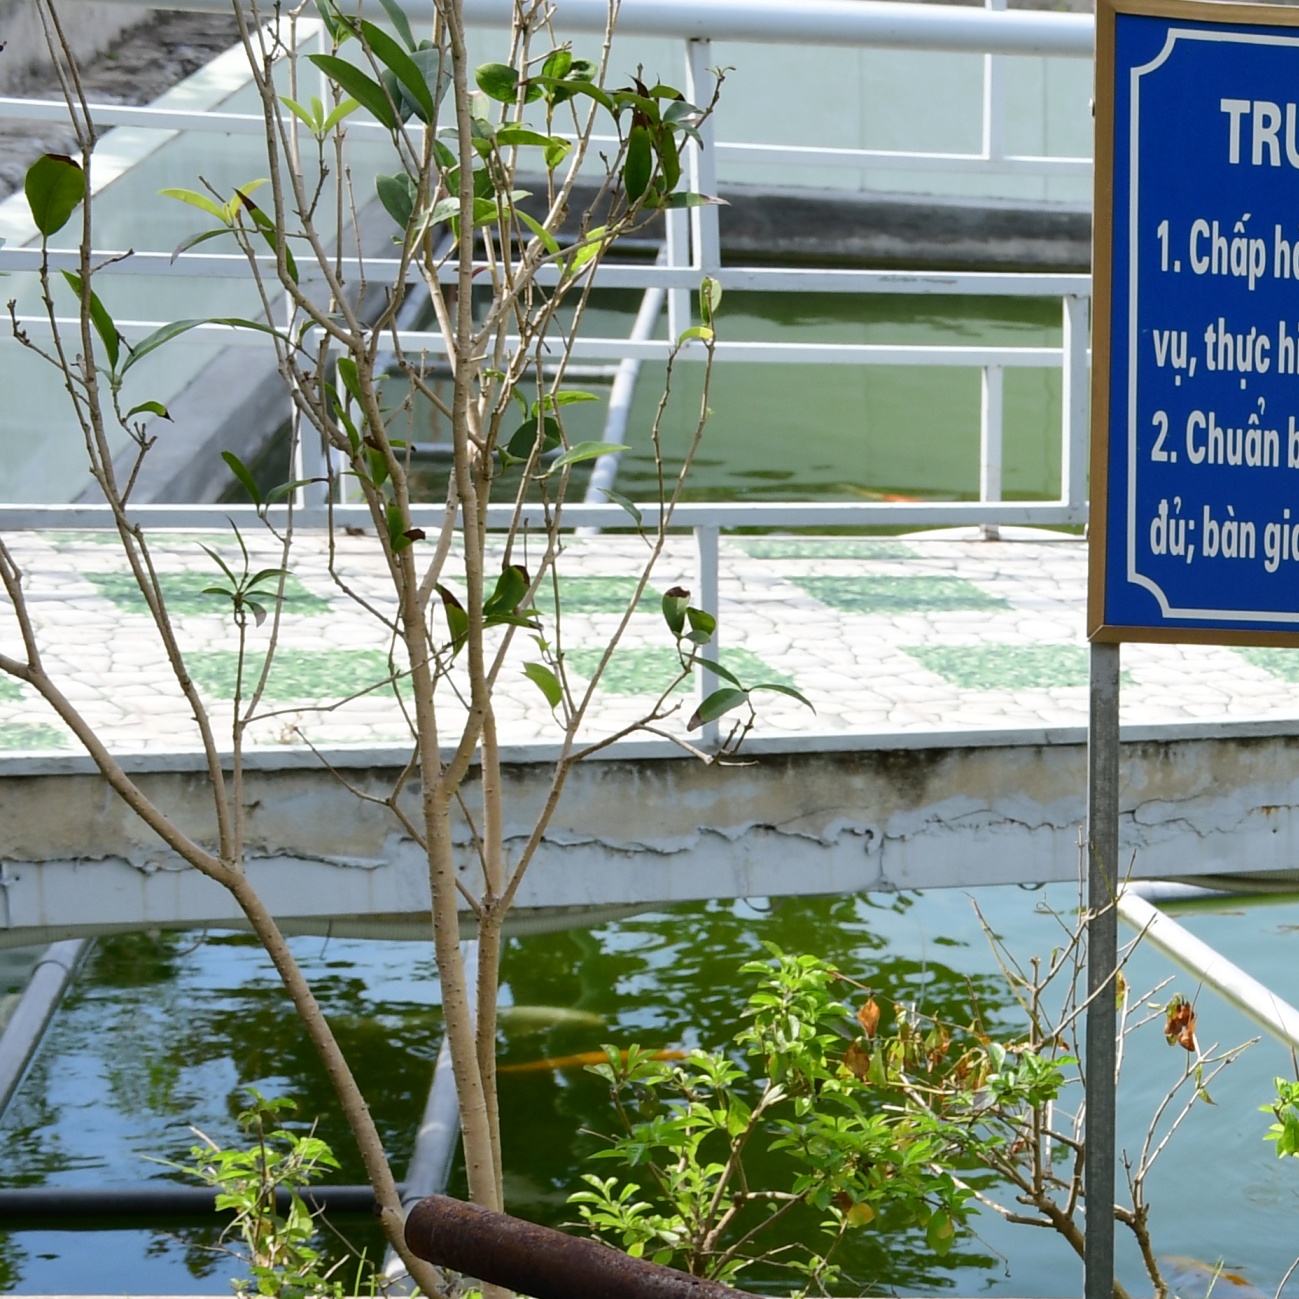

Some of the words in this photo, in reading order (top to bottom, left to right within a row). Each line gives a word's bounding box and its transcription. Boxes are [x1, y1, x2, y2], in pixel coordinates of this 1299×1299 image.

[1158, 219, 1180, 272] 1.
[1190, 214, 1265, 290] Chấp
[1153, 330, 1196, 385] vụ,
[1205, 318, 1270, 389] thực
[1152, 411, 1176, 462] 2.
[1187, 397, 1279, 466] Chuẩn
[1151, 497, 1196, 563] đủ;
[1203, 505, 1255, 559] bàn
